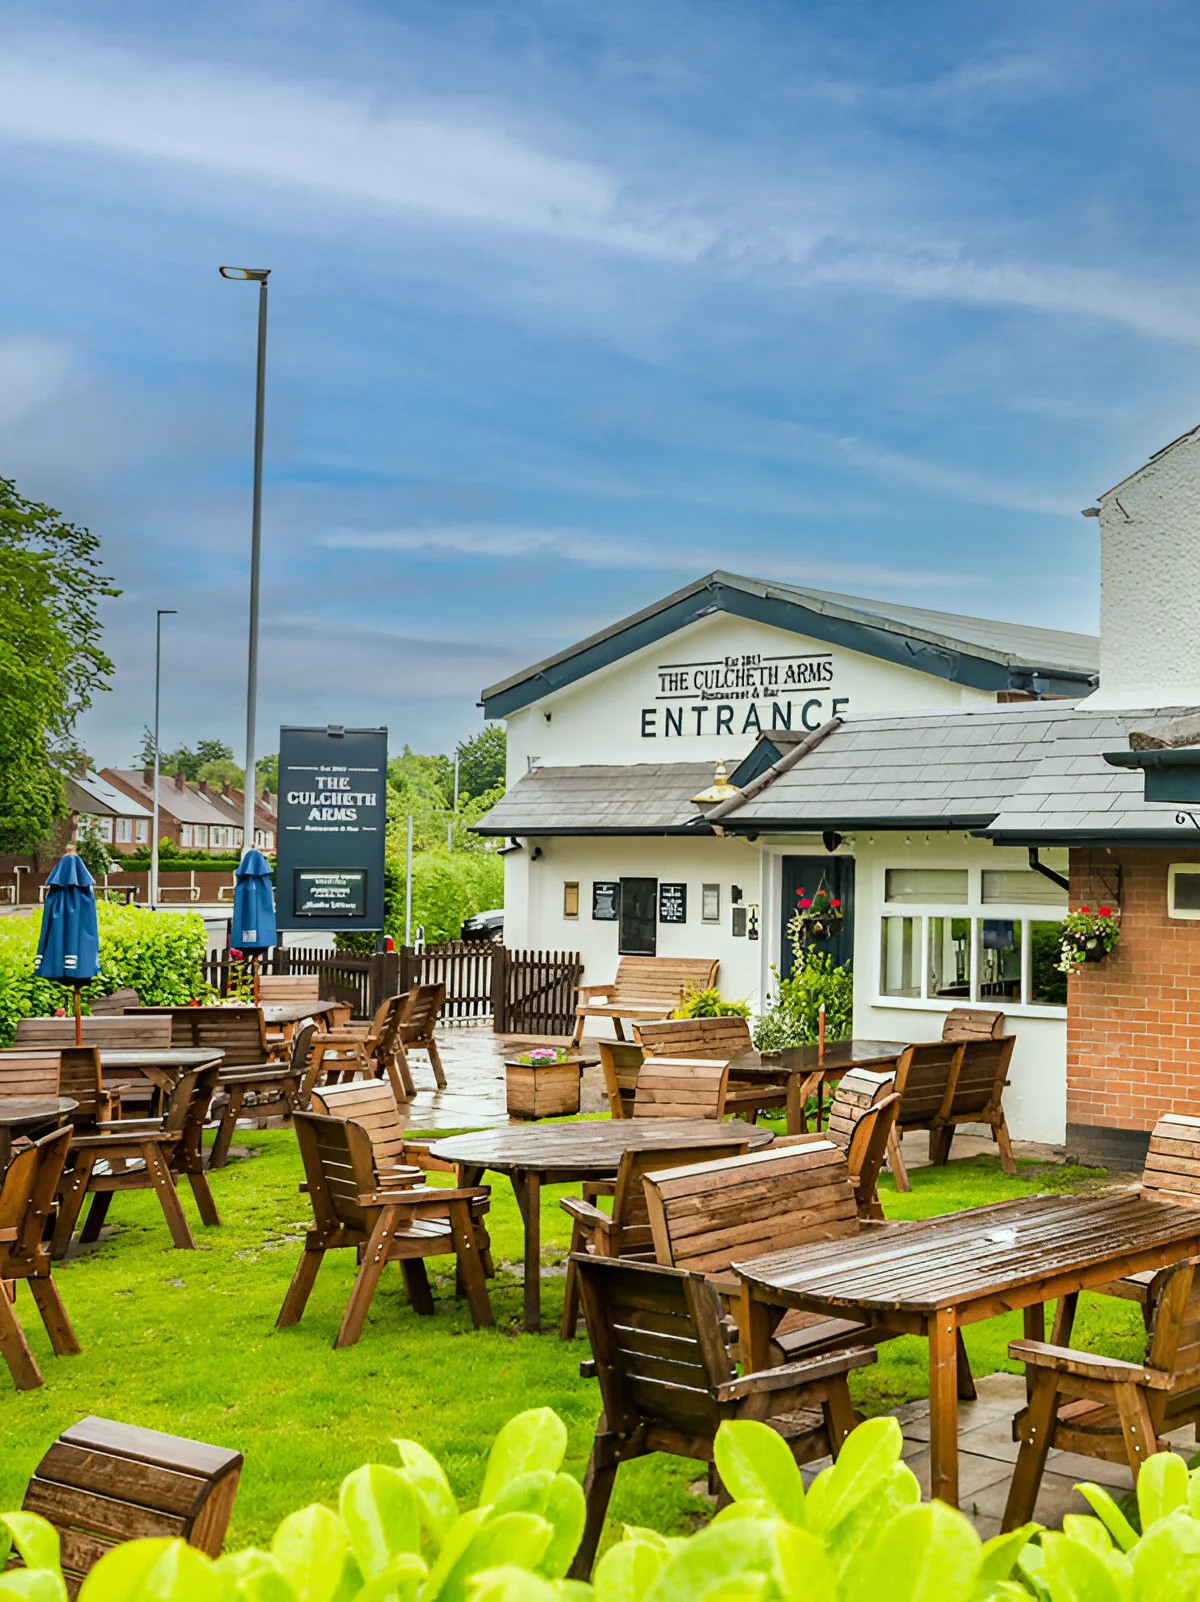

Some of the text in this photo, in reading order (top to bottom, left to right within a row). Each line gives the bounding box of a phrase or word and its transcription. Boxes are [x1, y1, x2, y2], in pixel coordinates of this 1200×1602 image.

[658, 661, 834, 692] THE CULCHETH ARMS
[641, 697, 850, 738] ENTRANCE
[315, 776, 351, 790] THE
[287, 791, 377, 806] CULCHETH
[308, 807, 358, 821] ARMS
